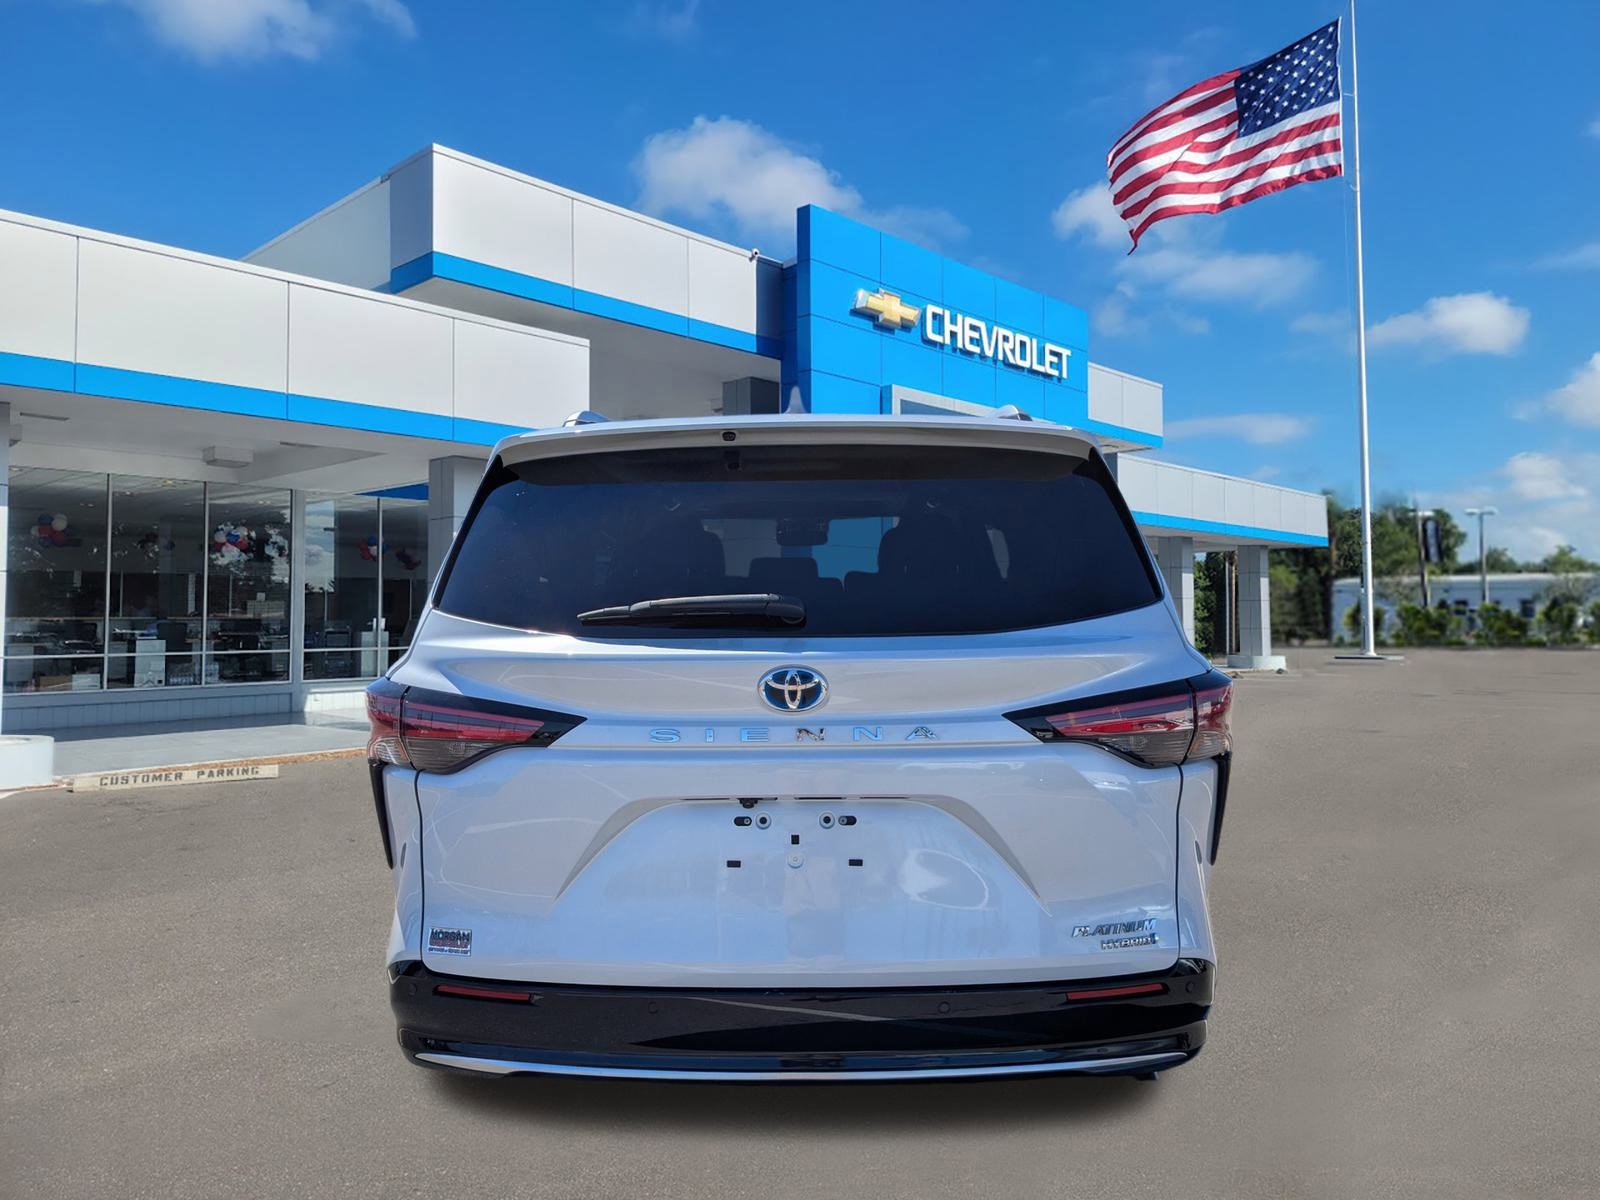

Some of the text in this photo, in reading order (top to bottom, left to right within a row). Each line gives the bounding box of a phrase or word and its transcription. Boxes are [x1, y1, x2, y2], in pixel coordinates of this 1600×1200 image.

[924, 304, 1072, 379] CHEVROLET
[649, 726, 939, 743] SIENNA
[99, 766, 260, 786] CUSTOMER PARKING
[1071, 918, 1157, 938] PLATINUM
[1101, 934, 1152, 950] HYBRID
